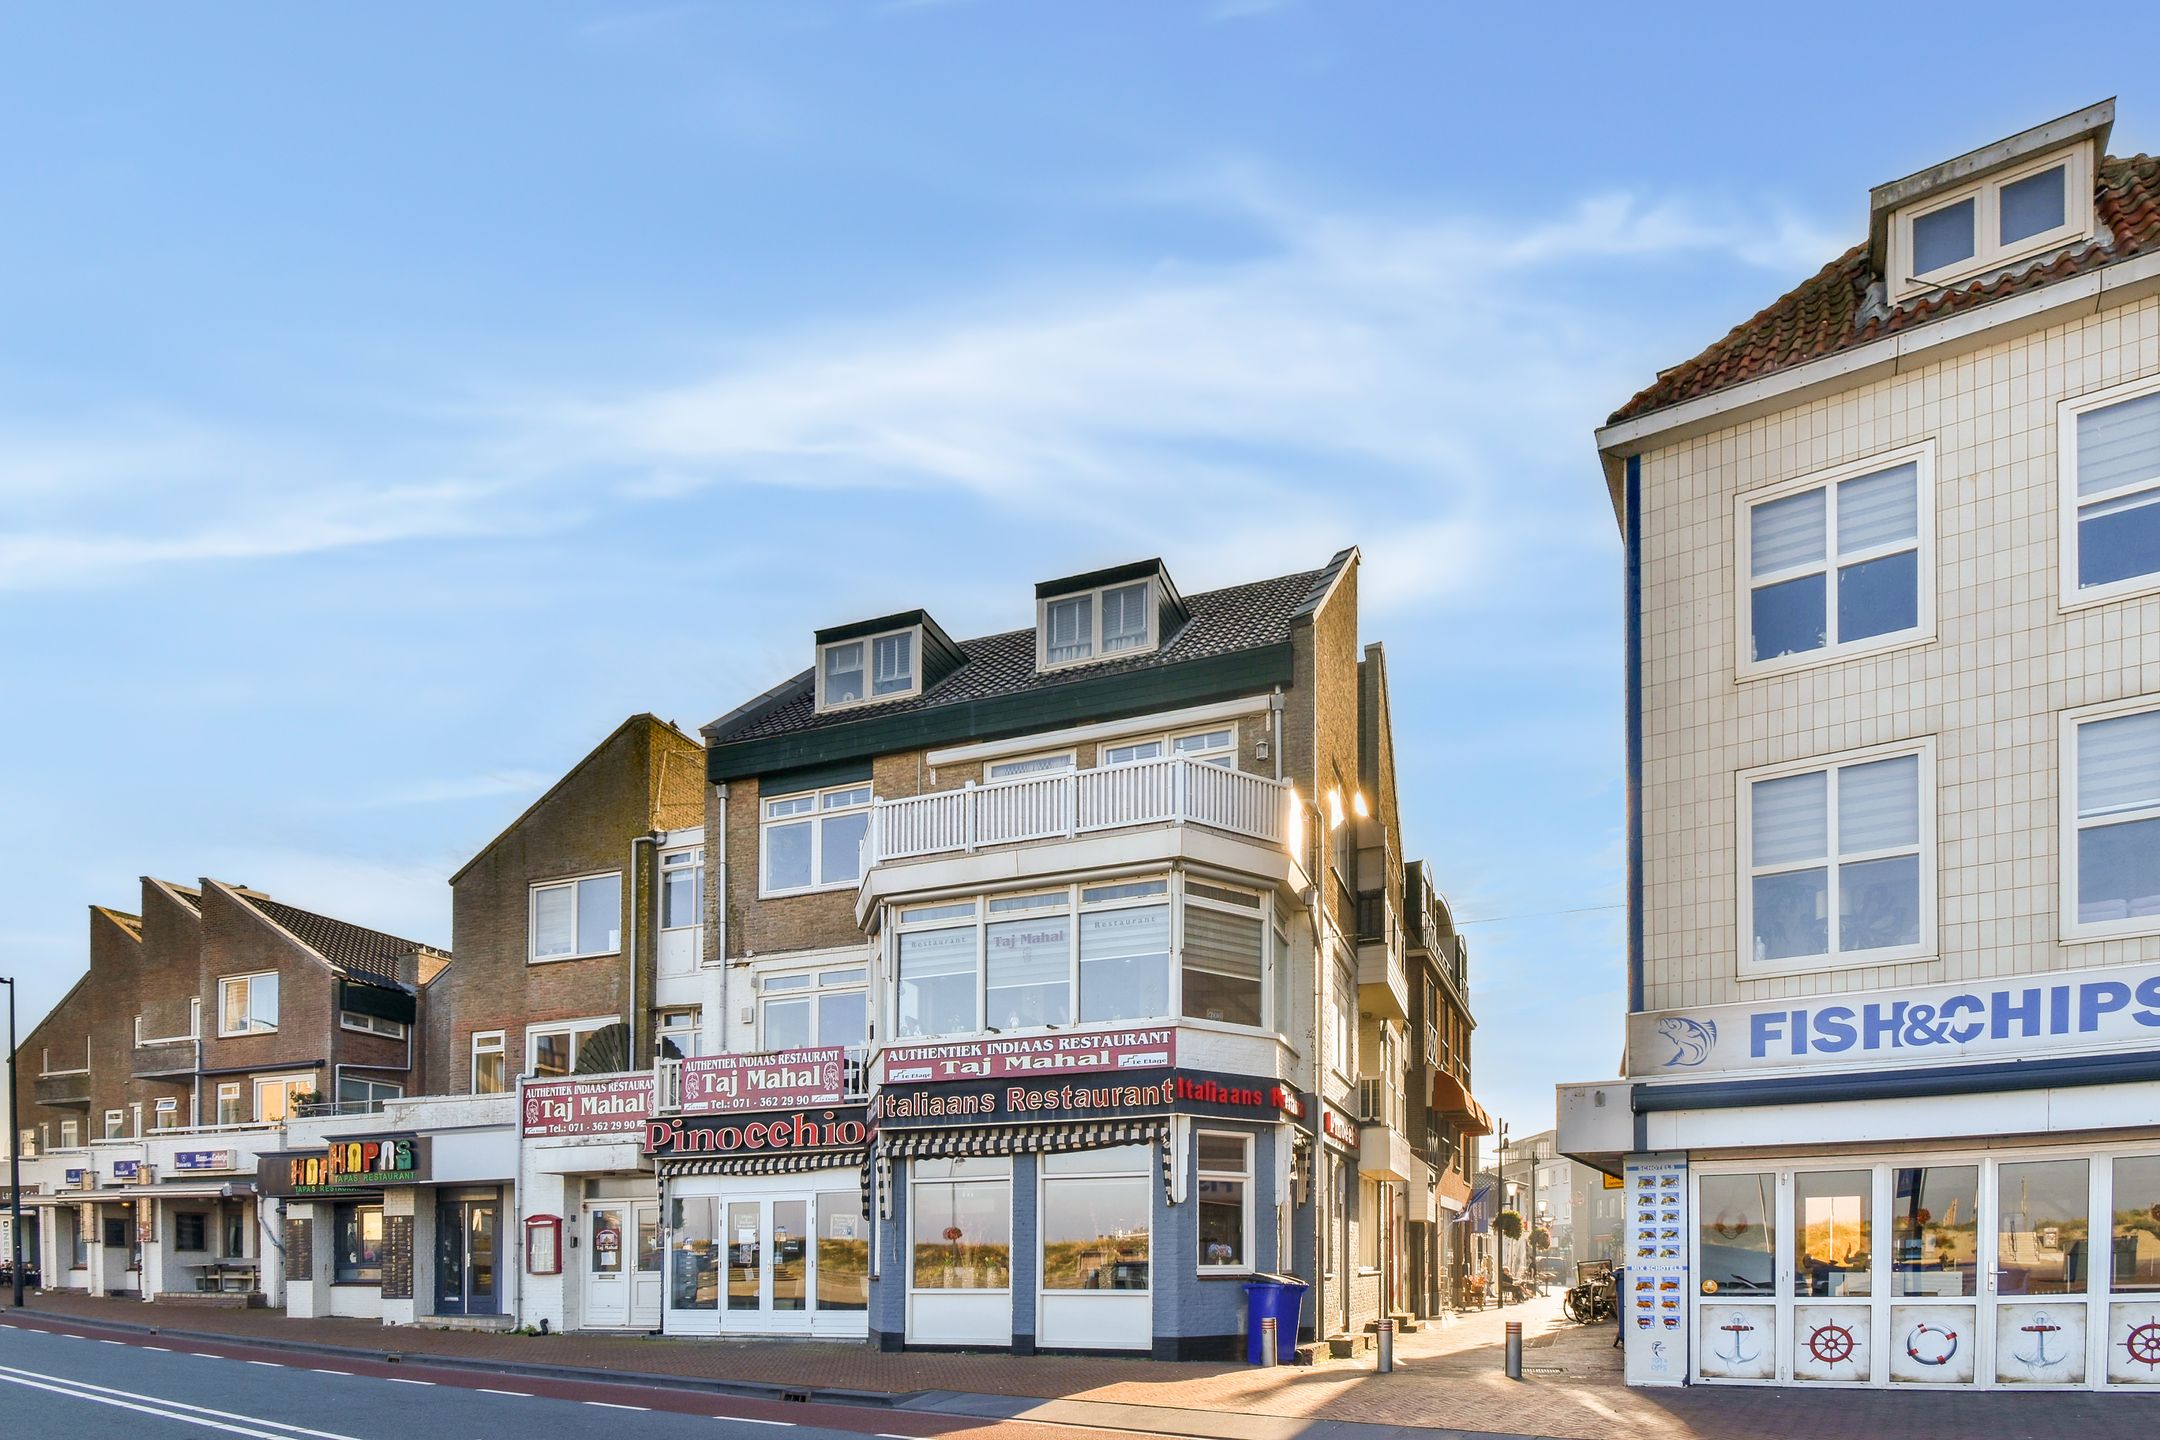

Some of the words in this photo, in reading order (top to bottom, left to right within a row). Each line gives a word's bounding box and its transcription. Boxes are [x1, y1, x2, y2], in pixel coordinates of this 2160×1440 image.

[1094, 916, 1156, 929] Restaurant
[912, 937, 967, 948] Restaurant
[993, 935, 1016, 950] Taj
[1020, 930, 1064, 945] Mahal
[887, 1044, 981, 1062] AUTHENTIEK
[987, 1039, 1053, 1055] INDIAAS
[1059, 1031, 1171, 1049] RESTAURANT
[685, 1058, 736, 1072] AUTHENTIEK
[739, 1055, 775, 1068] INDIAAS
[778, 1051, 839, 1065] RESTAURANT
[940, 1058, 991, 1076] Taj
[1004, 1051, 1111, 1071] Mahal
[526, 1085, 572, 1098] AUTHENTIEK
[574, 1082, 606, 1095] INDIAAS
[608, 1080, 655, 1092] RESTAURAN
[702, 1070, 738, 1097] Taj
[747, 1066, 821, 1090] Mahal
[1176, 1076, 1262, 1106] Italiaans
[541, 1097, 573, 1122] Taj
[581, 1093, 645, 1116] Mahal
[711, 1100, 730, 1109] Tel.:
[733, 1098, 750, 1108] 071
[760, 1097, 778, 1107] 362
[781, 1096, 793, 1106] 29
[797, 1095, 809, 1105] 90
[877, 1092, 995, 1118] Italiaans
[1007, 1078, 1174, 1111] Restaurant
[549, 1124, 566, 1133] Tel.:
[568, 1123, 584, 1132] 071
[592, 1121, 608, 1131] 362
[611, 1121, 622, 1130] 29
[624, 1120, 635, 1130] 90
[644, 1111, 865, 1153] Pinocchio
[329, 1140, 412, 1174] HOPAS
[334, 1174, 358, 1184] TAPAS
[364, 1172, 415, 1181] RESTAURANT
